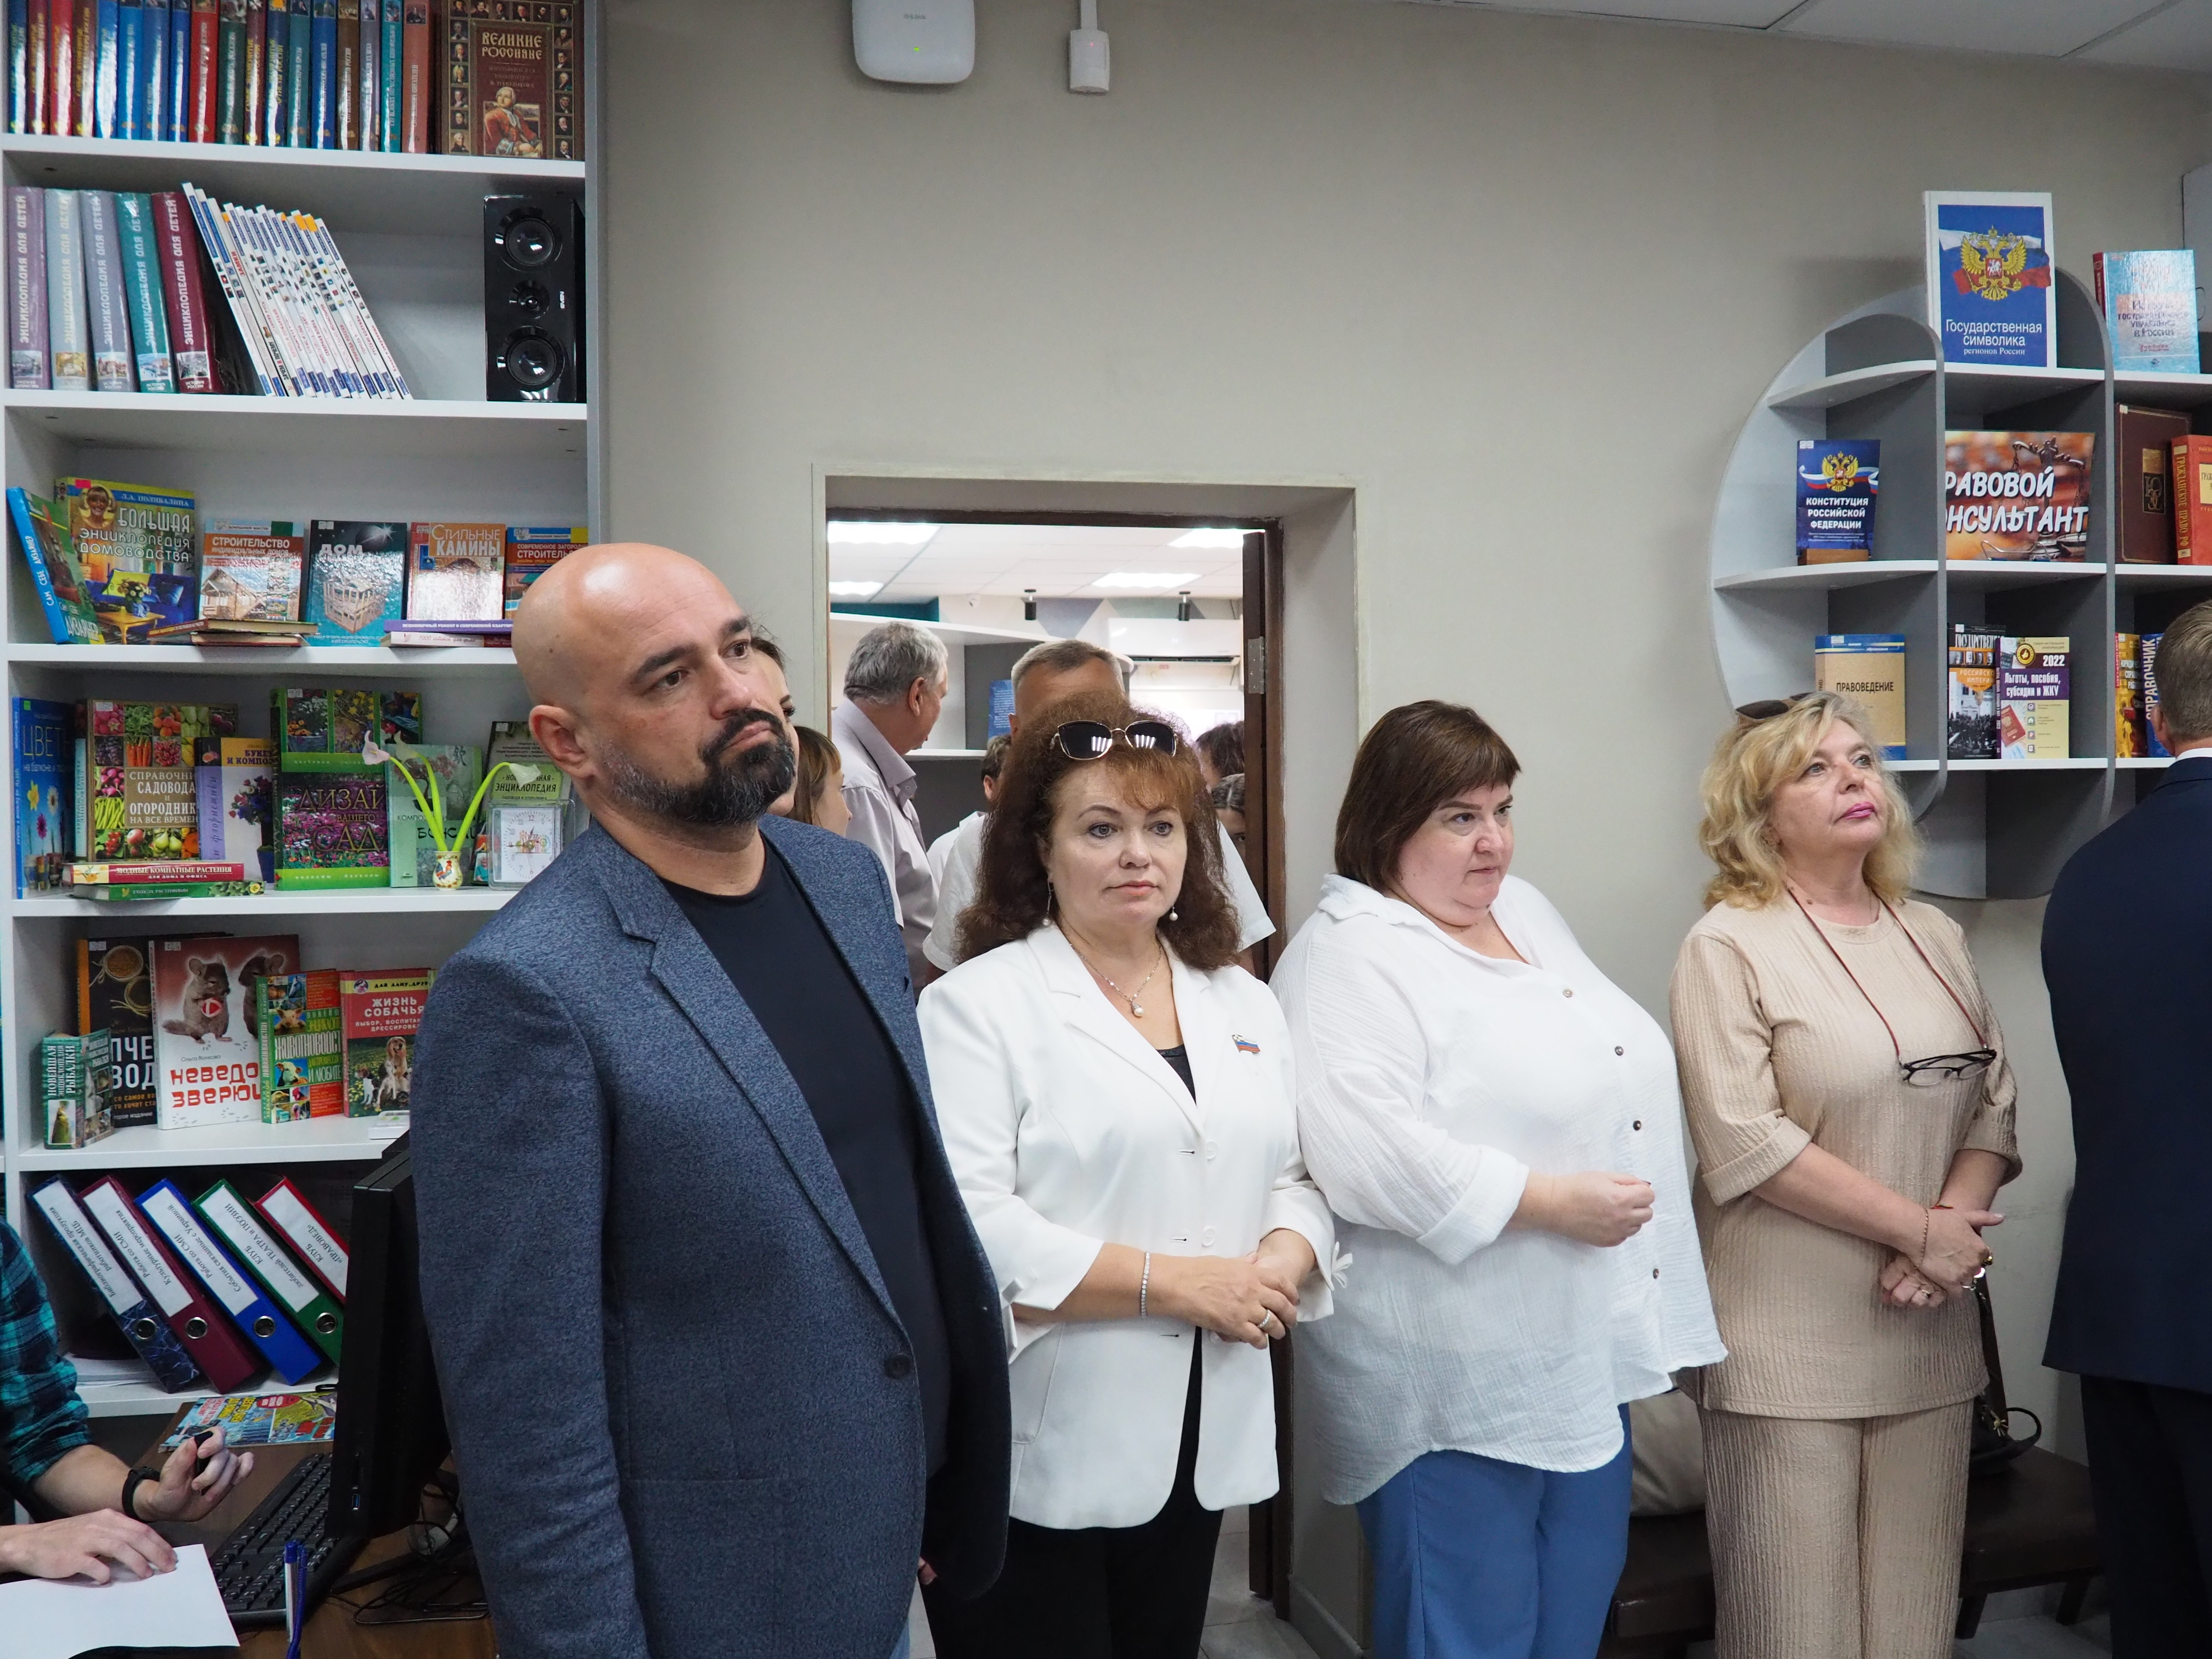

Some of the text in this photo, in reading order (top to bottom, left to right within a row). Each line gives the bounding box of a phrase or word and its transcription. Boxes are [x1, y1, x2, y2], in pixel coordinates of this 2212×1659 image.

[482, 32, 542, 48] ВЕЛИКИЕ
[482, 47, 542, 60] РОССИЯНЕ
[18, 232, 27, 253] ДЛЯ
[166, 200, 194, 345] ЭНЦИКЛОПЕДИЯ ДЛЯ ДЕТЕЙ
[230, 250, 245, 276] ЗАМКИ
[18, 258, 29, 343] ЭНЦИКЛОПЕДИЯ
[1946, 319, 2042, 335] Государственная
[268, 340, 280, 360] ПОЧЕМУ
[1963, 335, 2026, 348] символика
[1963, 348, 2025, 356] регионов России
[278, 364, 289, 380] ЗАЧЕМ
[1945, 465, 2055, 498] РАВОВОЙ
[1806, 497, 1869, 506] КОНСТИТУЦИЯ
[2176, 456, 2189, 547] ГРАЖДАНСКОЕ ПРАВО РФ
[118, 507, 190, 533] БОЛЬШАЯ
[1808, 507, 1865, 518] РОССИЙСКОЙ
[1946, 505, 2089, 533] НСУЛЬТАНТ
[1810, 520, 1862, 530] ФЕДЕРАЦИИ
[80, 528, 190, 549] ЭНЦИКЛОПЕДИЯ
[213, 537, 290, 549] СТРОИТЕЛЬСТВО
[319, 543, 364, 555] ДОМ
[437, 541, 500, 556] КАМИНЫ
[80, 542, 189, 563] ДОМОВОДСТВА
[517, 550, 573, 559] СТРОИТЕЛЬС
[25, 535, 54, 606] САМ СЕБЕ ДИЗАЙНЕР
[2043, 655, 2066, 667] 2022
[1836, 682, 1894, 694] ПРАВОВЕДЕНИЕ
[2005, 673, 2061, 685] Льготы, пособия,
[2006, 685, 2059, 698] субсидии и ЖКУ
[23, 725, 70, 760] ЦВЕТ
[138, 781, 196, 794] САДОВОДА
[296, 784, 384, 812] ДИЗАЙ
[495, 783, 556, 793] ЭНЦИКЛОПЕДИЯ
[130, 803, 197, 816] ОГОРОДНИК
[337, 814, 375, 822] ВАШЕГО
[313, 825, 384, 853] САД
[372, 997, 417, 1008] ЖИЗНЬ
[371, 1024, 419, 1032] ДРЕССИРОВК
[111, 1035, 153, 1062] ПЧЕ
[48, 1045, 57, 1096] НОВЕЙШАЯ
[66, 1045, 76, 1094] РЫБАЛКИ
[167, 1204, 193, 1233] Украиной
[224, 1203, 251, 1231] ПОЭЗИИ
[48, 1204, 116, 1298] Библиографическая продукция
[71, 1220, 111, 1272] работников МЦБ
[113, 1231, 150, 1278] Работа со СМИ
[115, 1208, 171, 1285] Культурные мероприятия
[194, 1237, 221, 1267] связанные
[252, 1233, 277, 1260] ТЕАТРА
[305, 1223, 343, 1265] «ПРАВОВЕД»
[305, 1243, 324, 1262] КЛУБ
[174, 1234, 213, 1278] Работа со СМИ
[244, 1245, 263, 1265] КЛУБ
[217, 1265, 241, 1292] События
[274, 1258, 303, 1289] любителей
